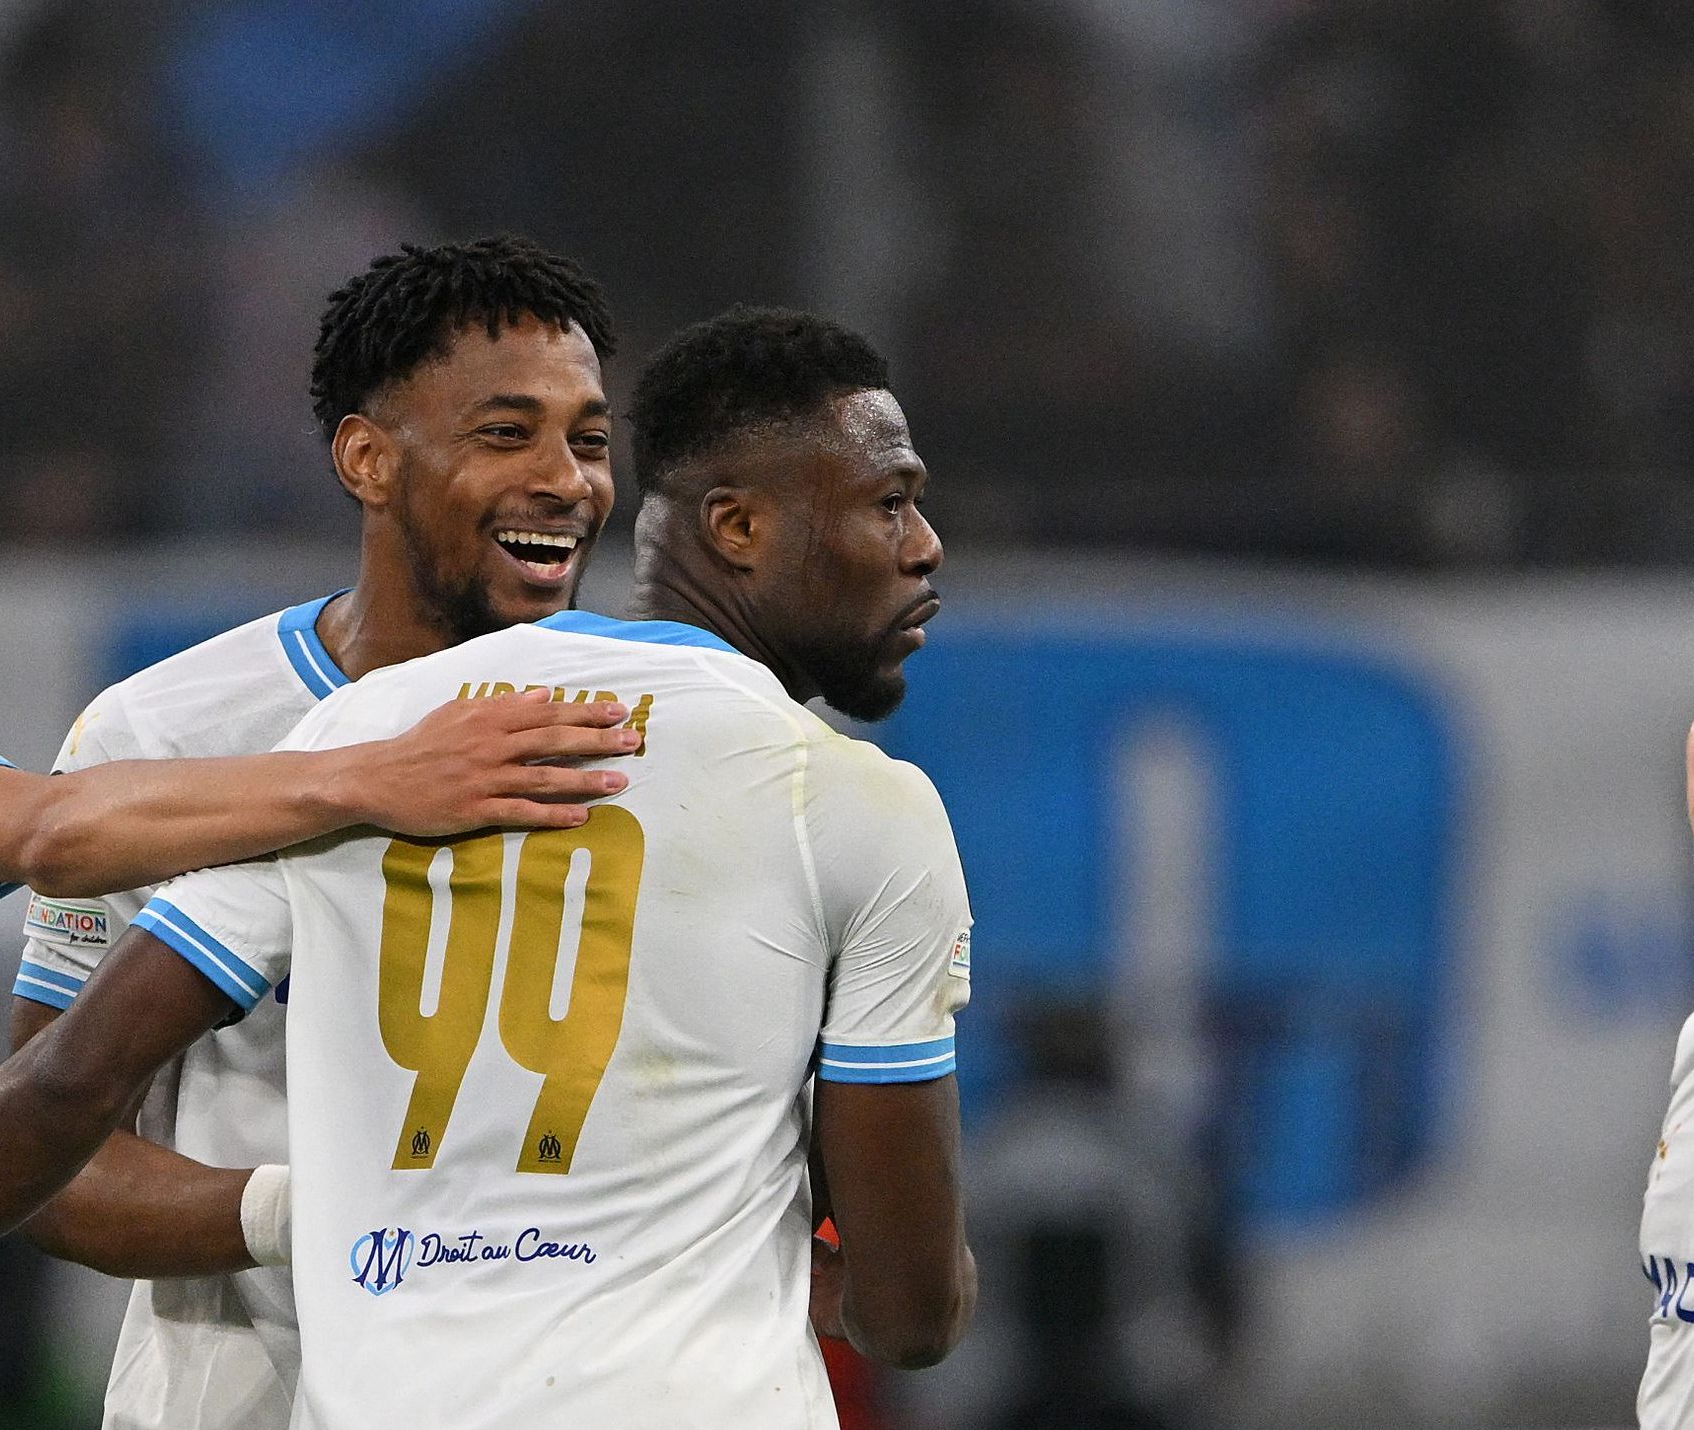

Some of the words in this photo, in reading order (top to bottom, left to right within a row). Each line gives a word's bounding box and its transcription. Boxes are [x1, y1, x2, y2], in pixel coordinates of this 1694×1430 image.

[377, 803, 647, 1174] 99
[416, 1230, 484, 1267] Droit
[481, 1242, 512, 1260] au
